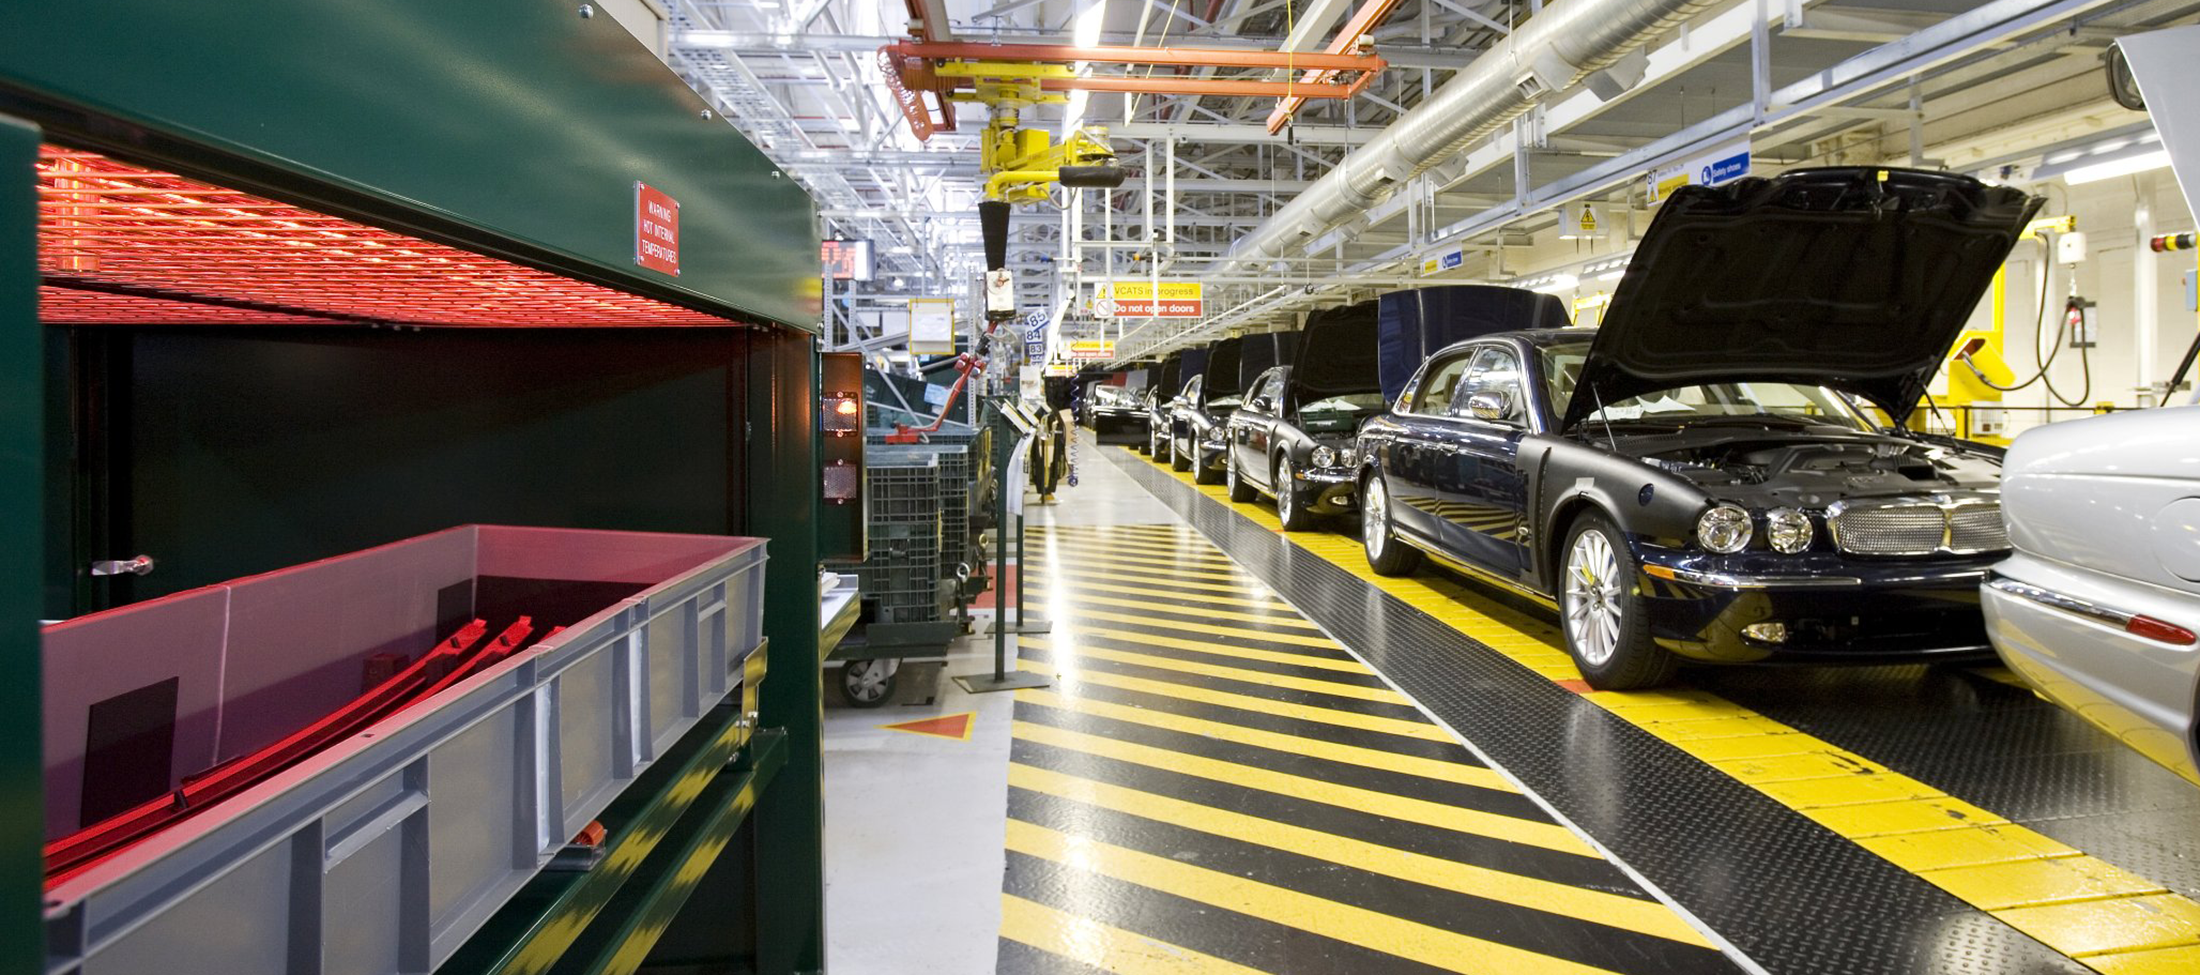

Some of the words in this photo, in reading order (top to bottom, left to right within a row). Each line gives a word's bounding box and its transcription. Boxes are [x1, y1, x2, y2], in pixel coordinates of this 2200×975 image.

[1648, 169, 1657, 184] 87
[648, 200, 671, 222] WARNING
[643, 219, 653, 235] HOT
[654, 224, 675, 244] INTERNAL
[642, 239, 677, 264] TEMPERATURES
[1114, 286, 1144, 295] VCATS
[1145, 286, 1153, 294] in
[1113, 303, 1127, 312] Do
[1128, 304, 1143, 312] not
[1169, 303, 1195, 312] doors
[1029, 311, 1046, 327] 85
[1026, 330, 1041, 340] 84
[1030, 344, 1042, 353] 83
